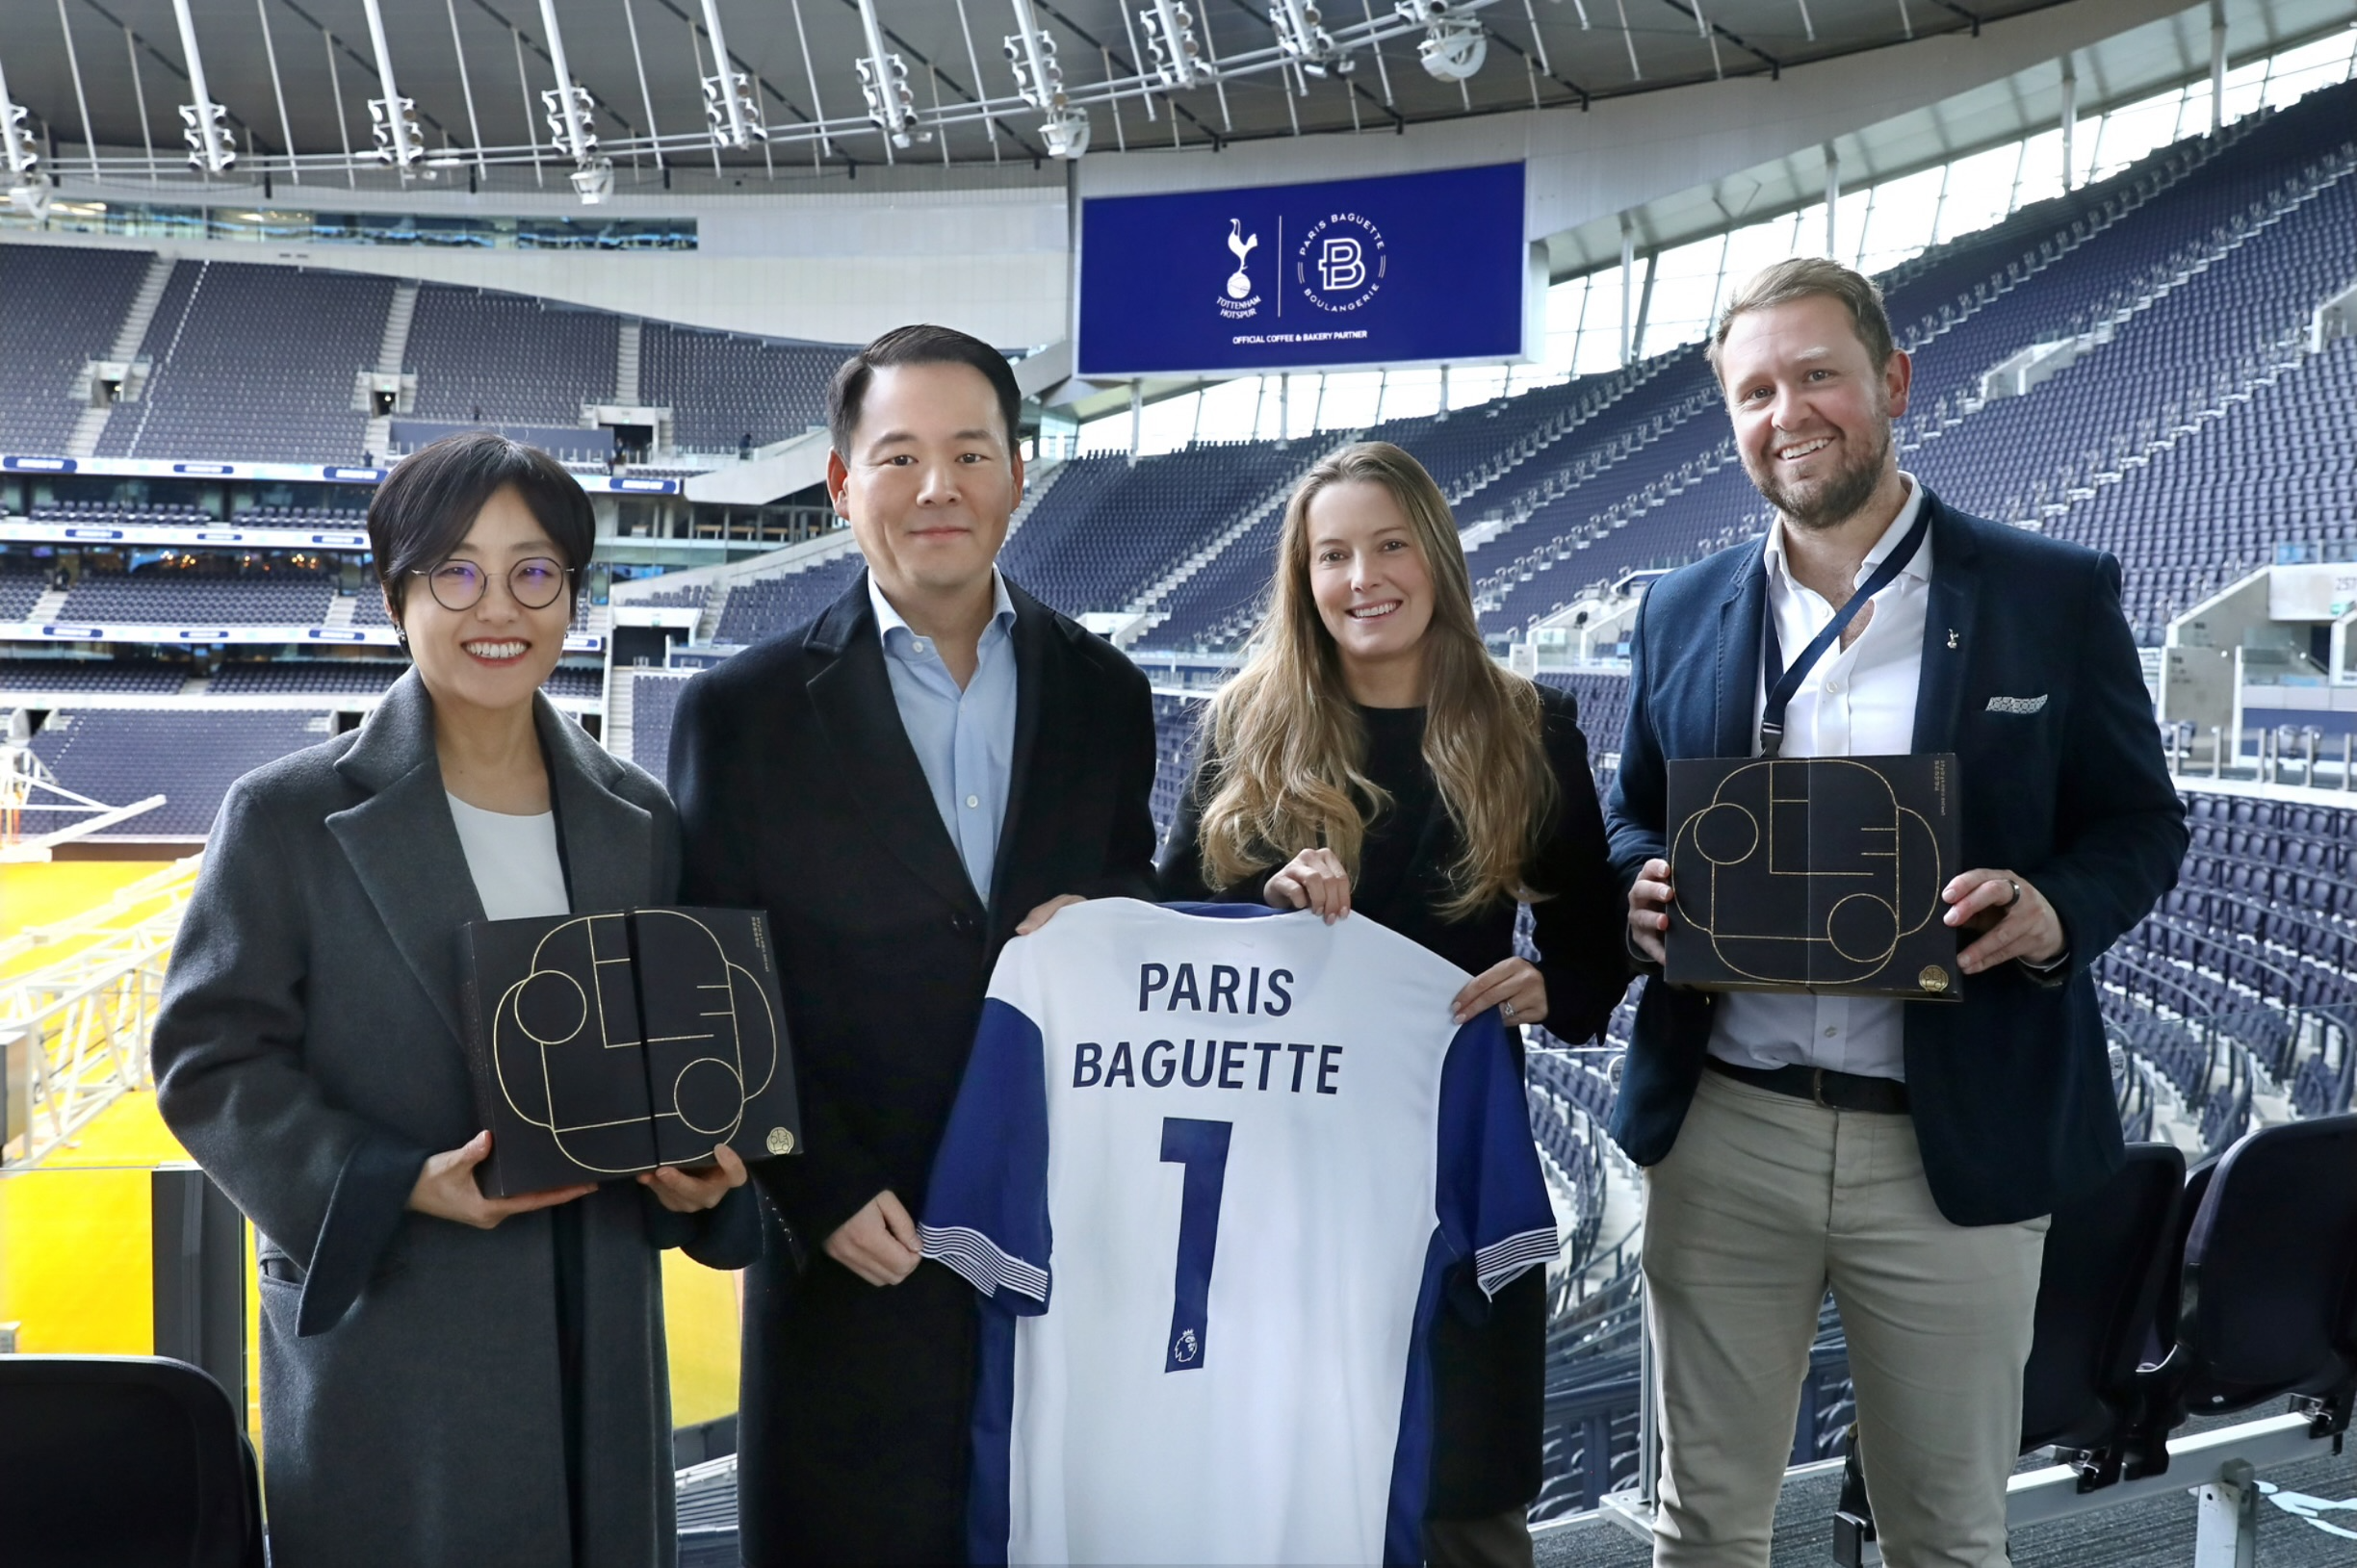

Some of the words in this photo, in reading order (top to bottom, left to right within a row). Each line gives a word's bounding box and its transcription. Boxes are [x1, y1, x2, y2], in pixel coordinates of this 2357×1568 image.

[1300, 220, 1327, 256] PARIS
[1331, 213, 1385, 250] BAGUETTE
[1216, 295, 1261, 310] TOTTENHAM
[1220, 307, 1257, 320] HOTSPUR
[1304, 283, 1379, 313] BOULANGERIE
[1232, 335, 1265, 345] OFFICIAL
[1266, 333, 1294, 343] COFFEE
[1295, 333, 1302, 342] &
[1303, 331, 1333, 342] BAKERY
[1334, 330, 1367, 340] PARTNER
[1139, 963, 1294, 1016] PARIS
[1073, 1039, 1343, 1094] BAGUETTE
[1159, 1117, 1232, 1374] 1
